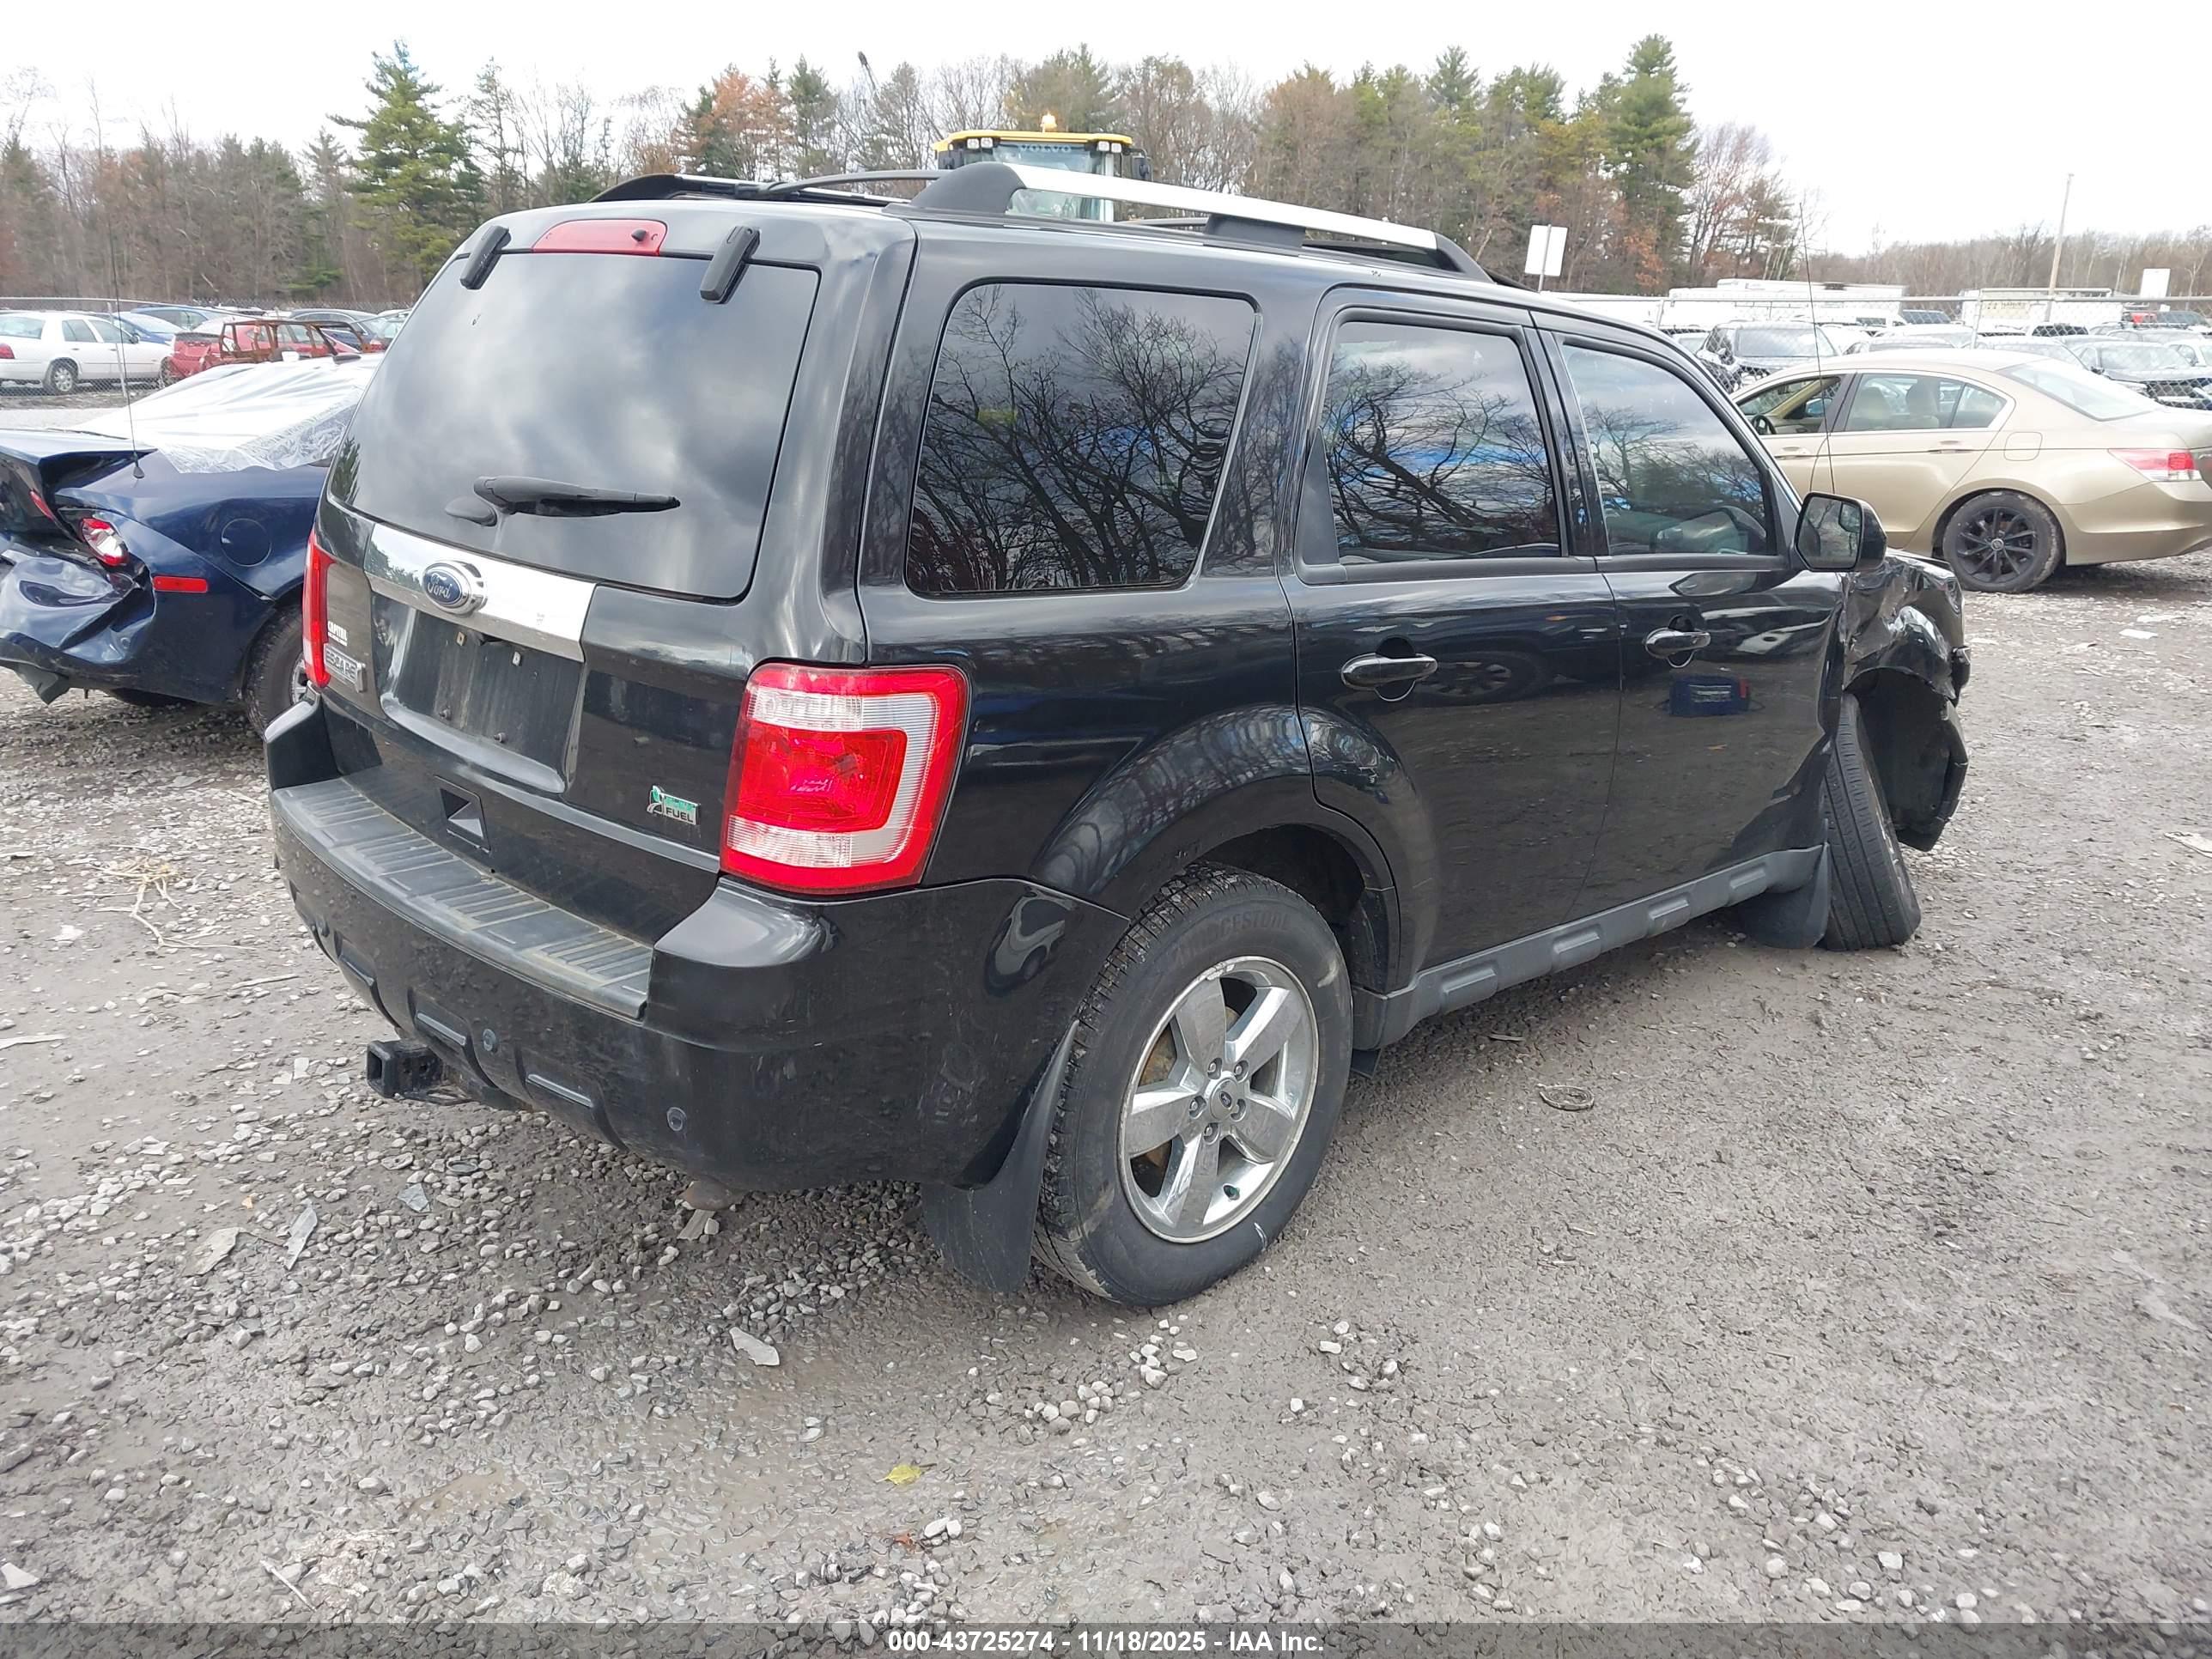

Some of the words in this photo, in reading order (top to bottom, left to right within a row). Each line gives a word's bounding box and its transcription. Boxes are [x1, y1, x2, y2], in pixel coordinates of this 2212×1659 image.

[1019, 144, 1072, 153] VOLVO
[428, 573, 453, 599] Ford
[325, 647, 358, 682] ESCAPE
[665, 807, 693, 823] FUEL
